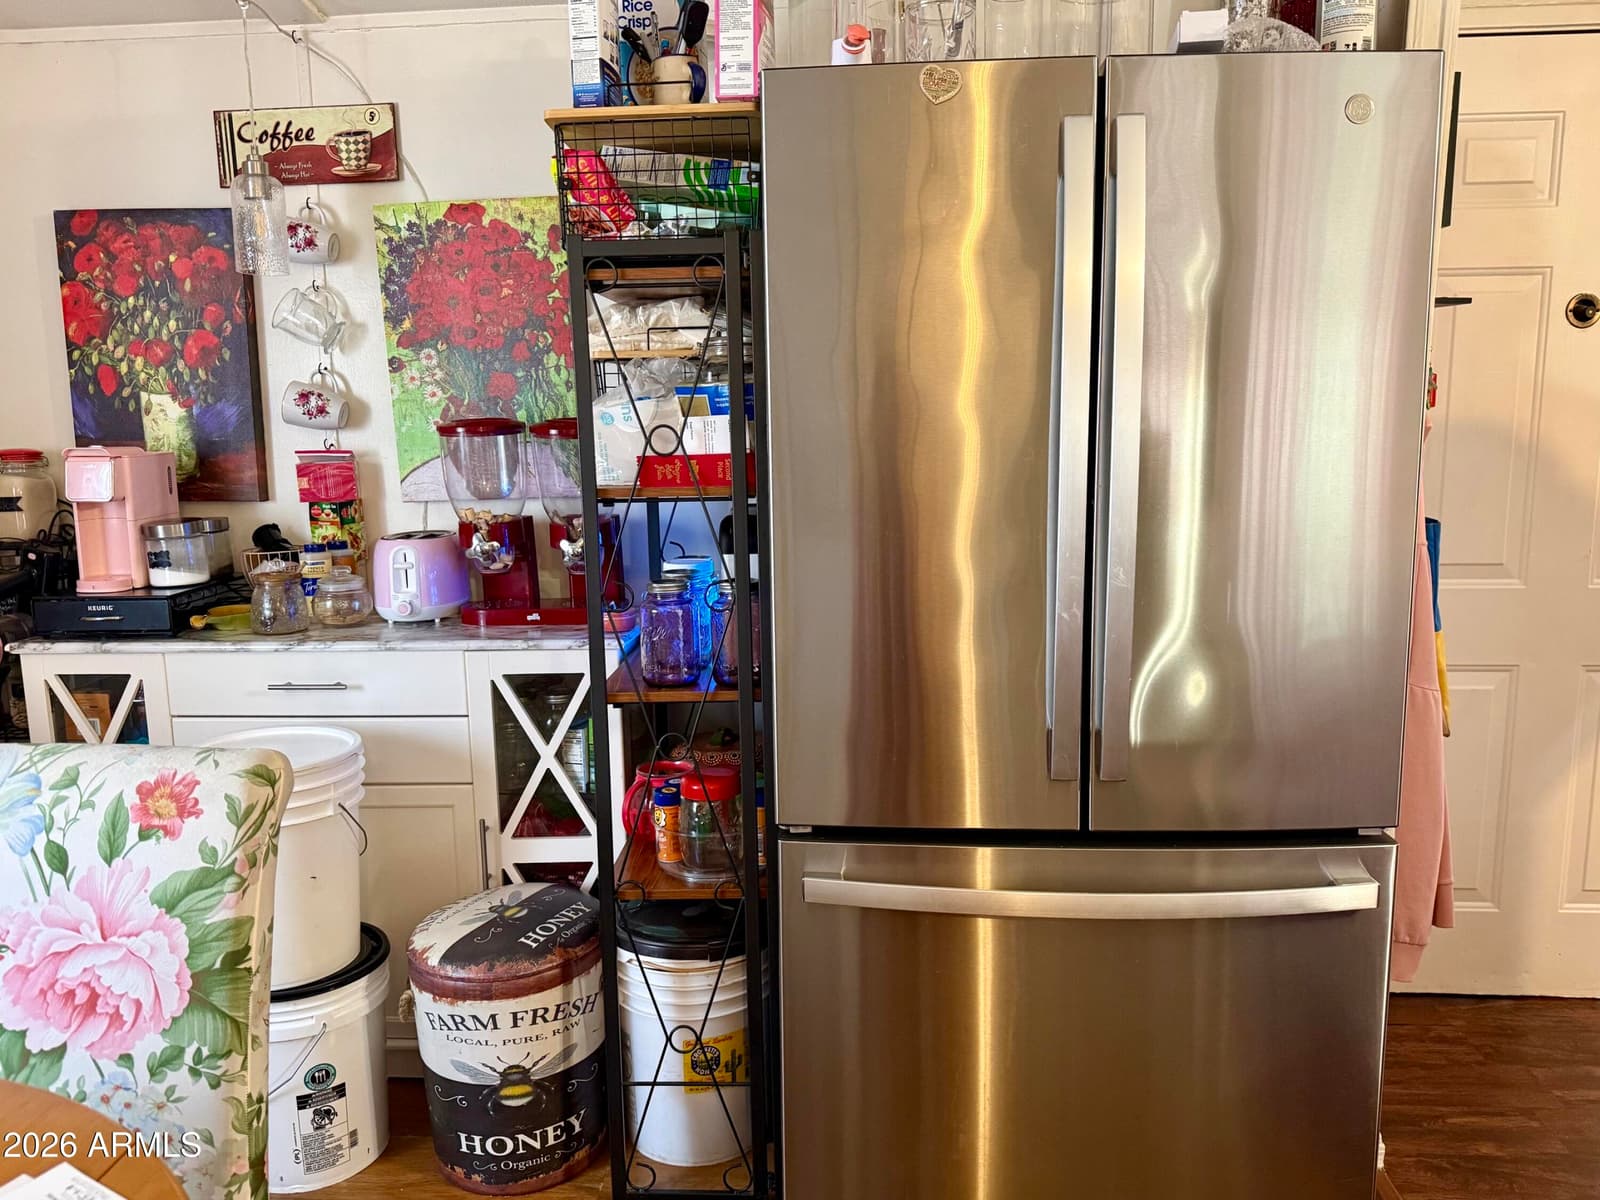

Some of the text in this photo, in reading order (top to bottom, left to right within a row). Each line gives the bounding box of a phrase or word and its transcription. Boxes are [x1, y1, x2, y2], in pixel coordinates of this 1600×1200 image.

[622, 0, 653, 12] Rice
[237, 121, 315, 151] Coffee
[517, 902, 592, 949] HONEY
[424, 991, 601, 1033] FARM FRESH
[446, 1034, 499, 1049] LOCAL,
[552, 1019, 581, 1037] RAW
[457, 1108, 587, 1158] HONEY
[500, 1154, 550, 1172] Organic
